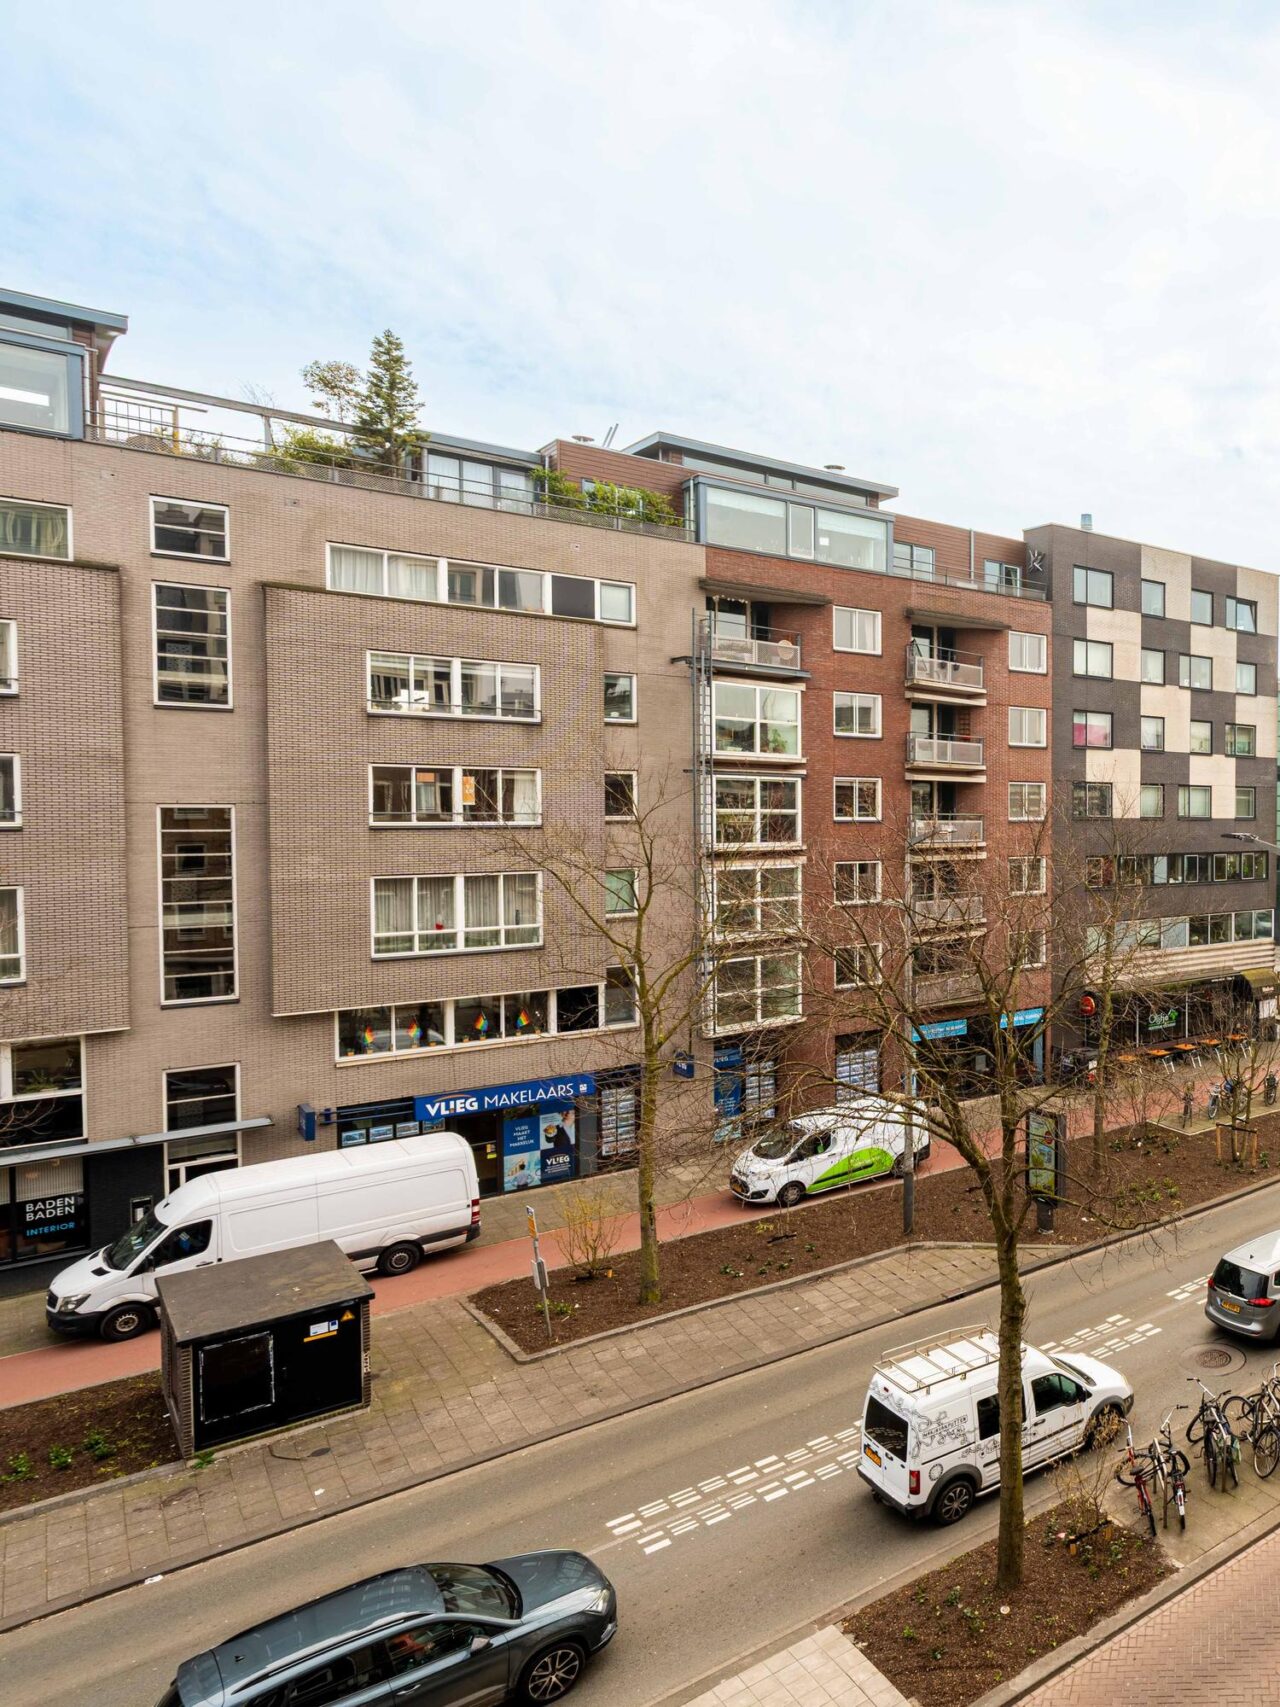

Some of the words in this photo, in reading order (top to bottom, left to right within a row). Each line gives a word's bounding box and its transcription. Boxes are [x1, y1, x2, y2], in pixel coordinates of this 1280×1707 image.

[426, 1097, 478, 1117] VLIEG
[484, 1083, 574, 1108] MAKELAARS
[546, 1155, 570, 1165] VLIEG
[26, 1196, 75, 1212] BADEN
[26, 1206, 75, 1221] BADEN
[26, 1222, 75, 1236] INTERIOR
